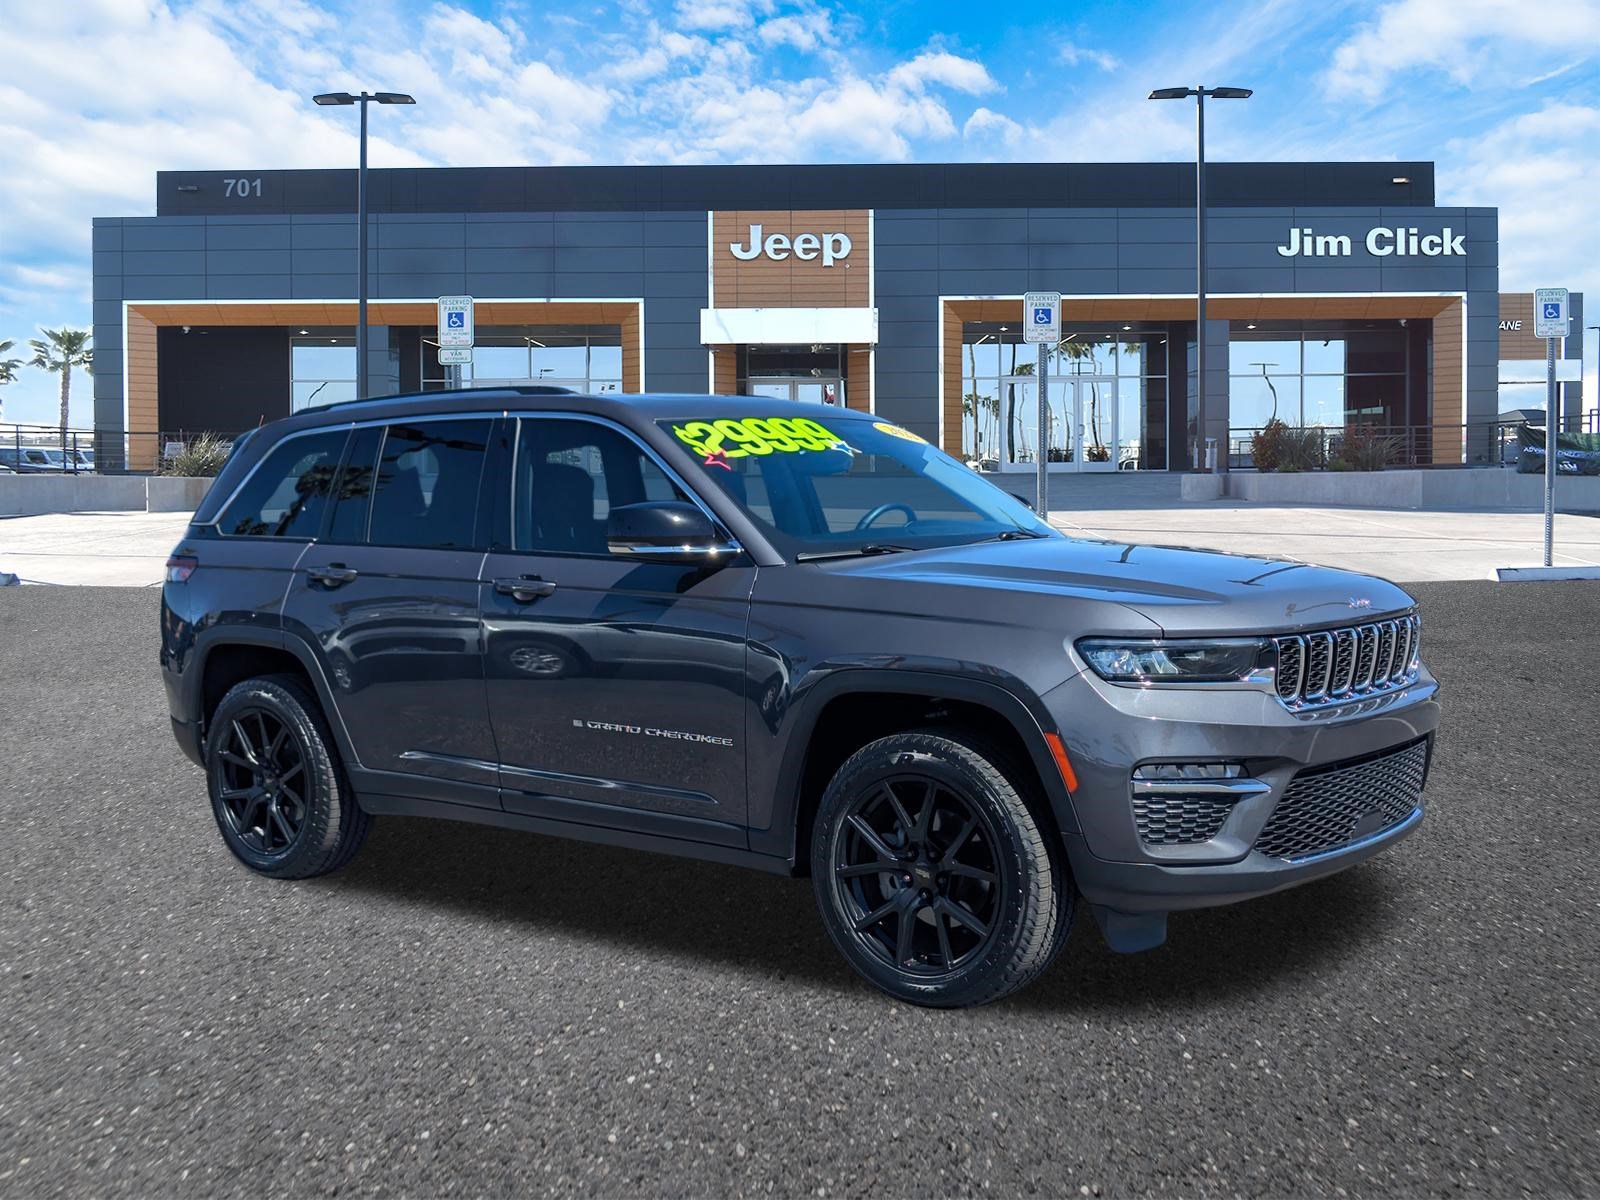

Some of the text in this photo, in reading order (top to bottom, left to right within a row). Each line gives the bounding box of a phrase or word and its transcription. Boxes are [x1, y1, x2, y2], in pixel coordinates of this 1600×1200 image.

[223, 178, 262, 197] 701
[729, 223, 852, 267] Jeep
[1277, 226, 1467, 257] Jim Click
[1498, 320, 1522, 331] ANE
[587, 721, 734, 747] GRAND CHEROKEE
